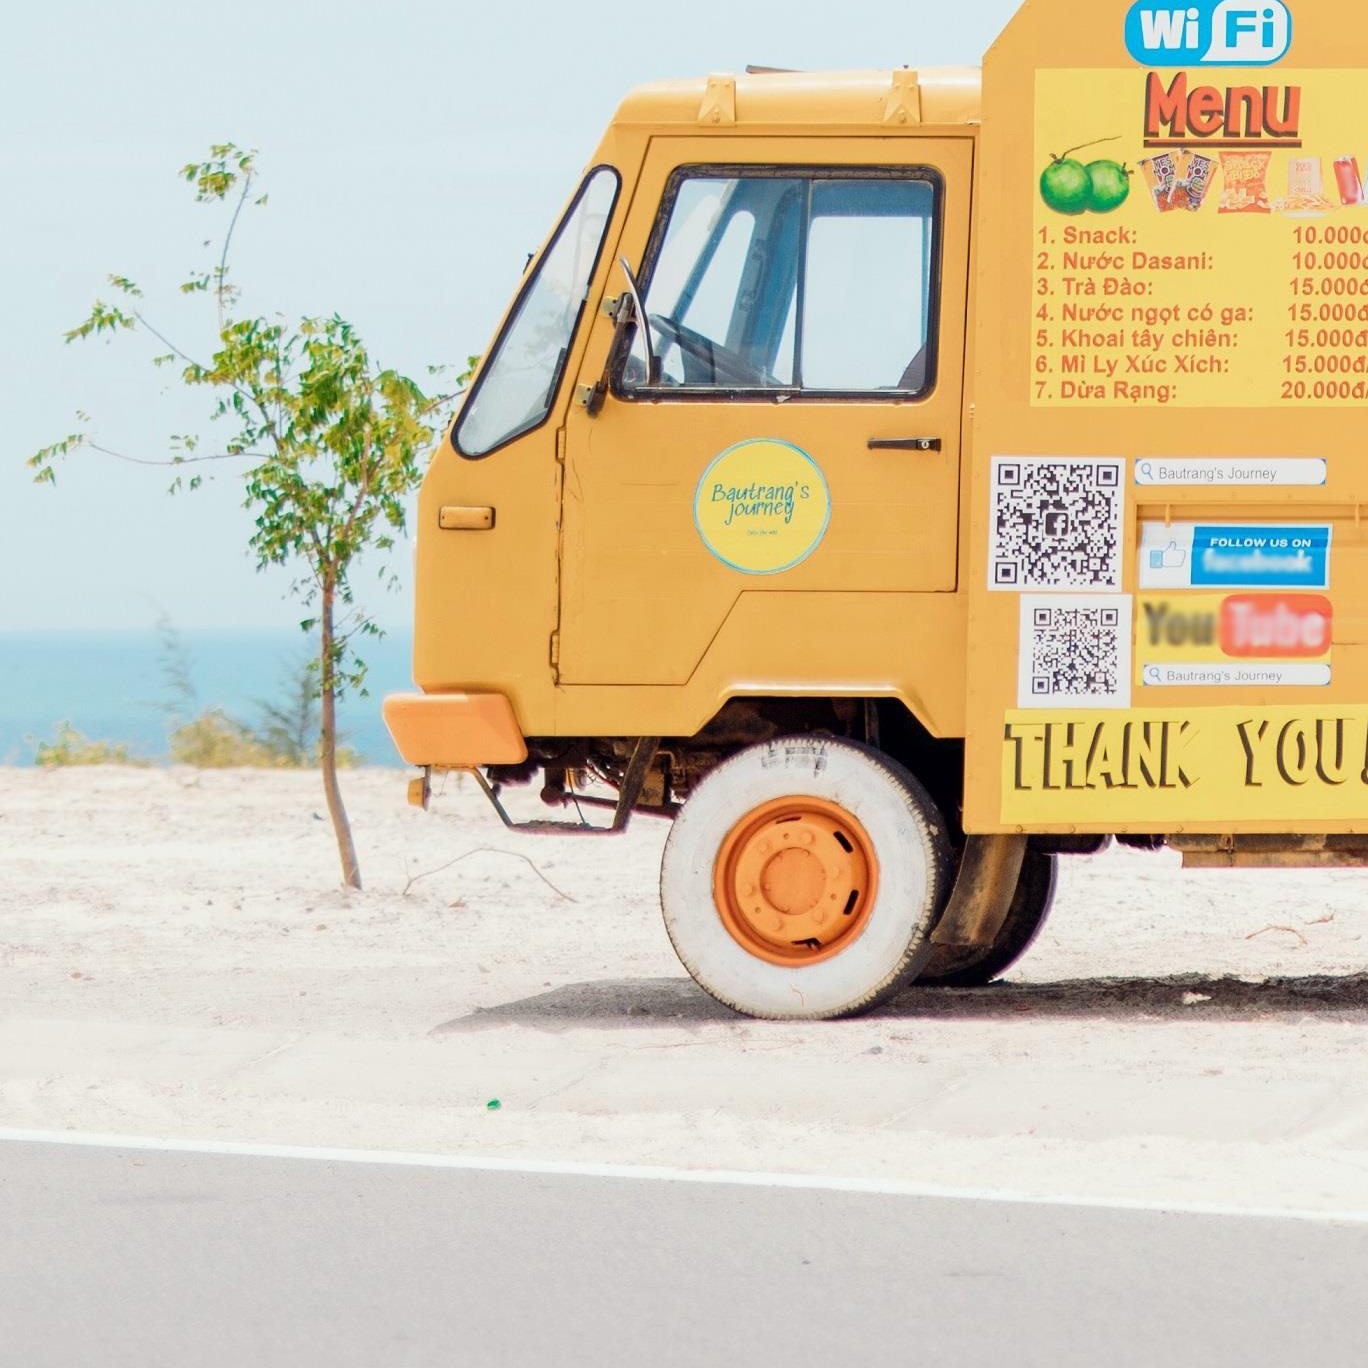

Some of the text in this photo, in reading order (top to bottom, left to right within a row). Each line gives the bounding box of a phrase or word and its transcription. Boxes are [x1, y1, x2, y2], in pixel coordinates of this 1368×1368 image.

[1144, 71, 1301, 139] Menu
[1038, 226, 1055, 244] 1.
[1063, 226, 1137, 244] Snack:
[1037, 252, 1055, 270] 2.
[1063, 251, 1124, 270] Nước
[1132, 251, 1213, 270] Dasani:
[1037, 277, 1054, 295] 3.
[1063, 277, 1096, 295] Trà
[1103, 277, 1153, 295] Đào:
[1036, 303, 1054, 321] 4.
[1062, 303, 1123, 321] Nước
[1132, 304, 1180, 327] ngọt
[1188, 303, 1213, 321] có
[1221, 308, 1253, 326] ga:
[1036, 329, 1053, 347] 5.
[1062, 329, 1125, 347] Khoai
[1132, 329, 1164, 351] tây
[1172, 329, 1238, 347] chiên:
[1035, 355, 1053, 373] 6.
[1062, 355, 1086, 373] Mì
[1094, 355, 1118, 377] Ly
[1126, 355, 1166, 373] Xúc
[1175, 355, 1229, 373] Xích:
[1035, 381, 1052, 399] 7.
[1061, 380, 1105, 399] Dừa
[1114, 381, 1177, 403] Rạng:
[1159, 467, 1277, 481] Bautrang's Journey
[712, 480, 810, 505] Bautrang's
[724, 501, 794, 525] journey
[1210, 538, 1311, 547] FOLLOW US ON
[1167, 671, 1282, 683] Bautrang's Journey
[1005, 721, 1201, 790] THANK
